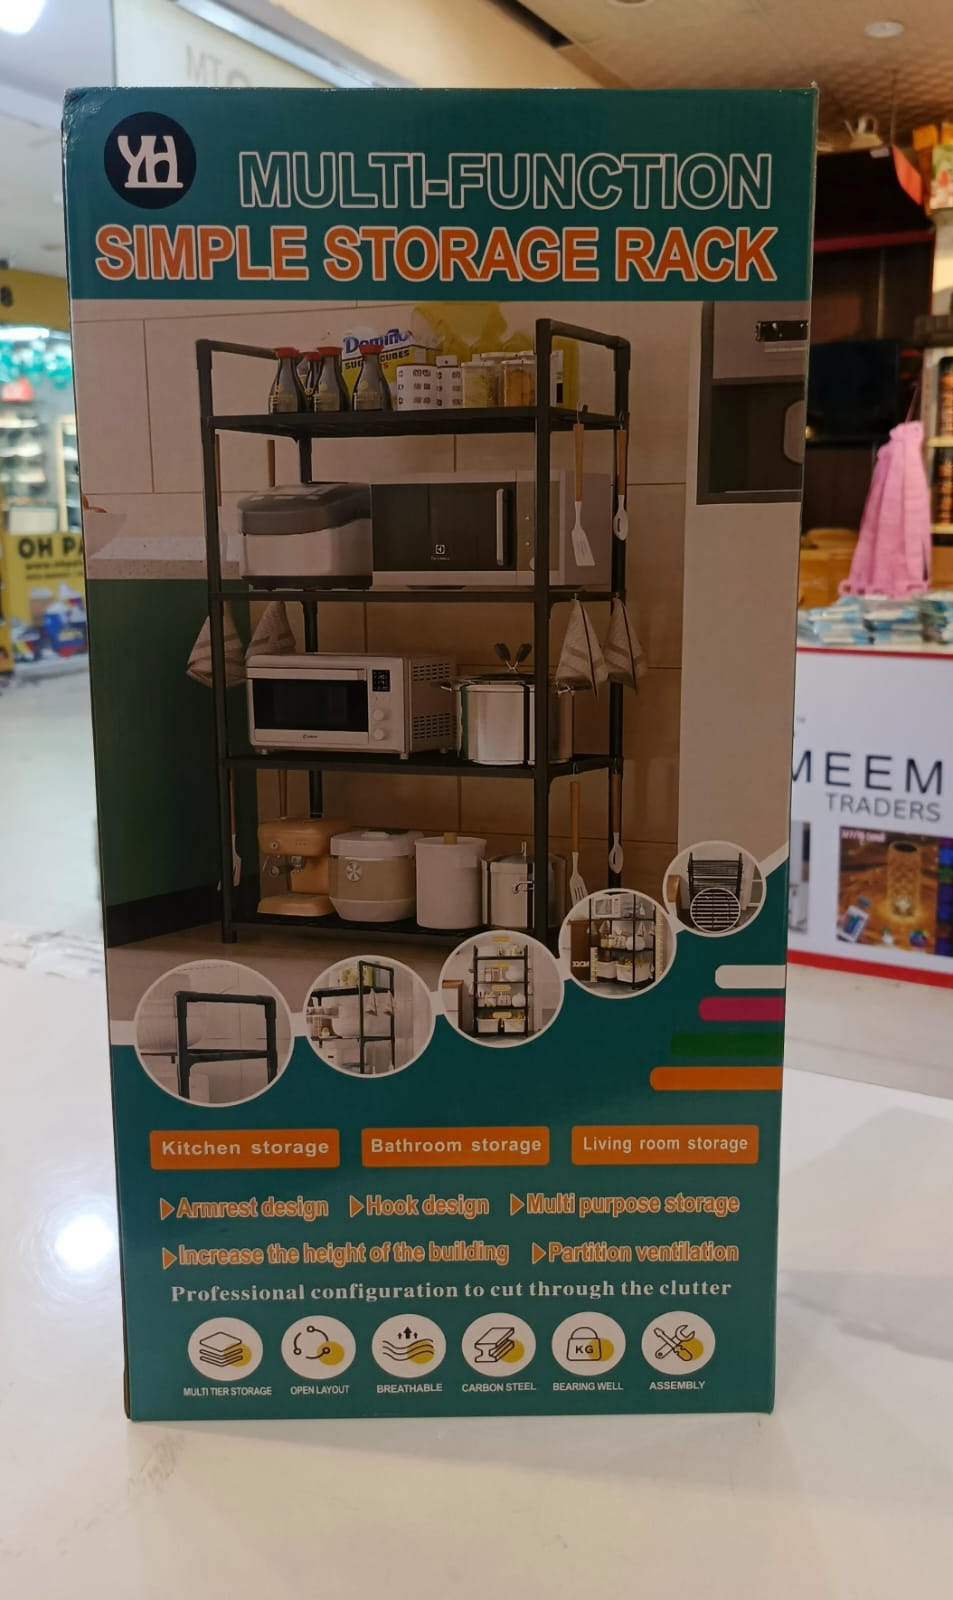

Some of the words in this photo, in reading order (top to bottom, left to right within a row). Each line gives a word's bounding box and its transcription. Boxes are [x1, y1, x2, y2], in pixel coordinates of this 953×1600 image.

[239, 152, 772, 210] MULTI-FUNCTION
[95, 223, 309, 281] SIMPLE
[323, 225, 599, 282] STORAGE
[615, 225, 778, 282] RACK
[825, 791, 941, 823] TRADERS
[162, 1140, 241, 1156] Kitchen
[251, 1140, 329, 1157] storage
[370, 1138, 462, 1154] Bathroom
[471, 1139, 542, 1155] storage
[583, 1136, 632, 1154] Living
[639, 1139, 680, 1150] room
[687, 1136, 748, 1153] storage
[176, 1196, 258, 1219] Armrest
[261, 1195, 329, 1222] design
[366, 1194, 419, 1216] Hook
[422, 1194, 489, 1220] design
[526, 1192, 576, 1214] Multi
[579, 1195, 661, 1218] purpose
[664, 1192, 740, 1217] storage
[178, 1244, 265, 1265] Increase
[267, 1243, 299, 1263] the
[303, 1242, 367, 1268] height
[369, 1241, 391, 1262] of
[393, 1241, 425, 1262] the
[429, 1240, 510, 1266] building
[548, 1241, 632, 1263] Partition
[635, 1241, 740, 1262] ventilation
[171, 1284, 305, 1302] Professional
[310, 1282, 458, 1302] configuration
[464, 1282, 485, 1297] to
[490, 1281, 523, 1297] cut
[529, 1280, 615, 1300] through
[621, 1280, 654, 1296] the
[659, 1280, 732, 1296] clutter
[575, 1344, 594, 1354] KG
[183, 1386, 209, 1397] MULTI
[209, 1386, 231, 1396] TIER
[231, 1386, 273, 1396] STORAGE
[290, 1385, 315, 1395] OPEN
[316, 1384, 350, 1394] LAYOUT
[376, 1383, 443, 1394] BREATHABLE
[462, 1383, 504, 1393] CARBON
[505, 1382, 537, 1392] STEEL
[553, 1382, 596, 1392] BEARING
[597, 1382, 624, 1392] WELL
[649, 1380, 706, 1391] ASSEMBLY
